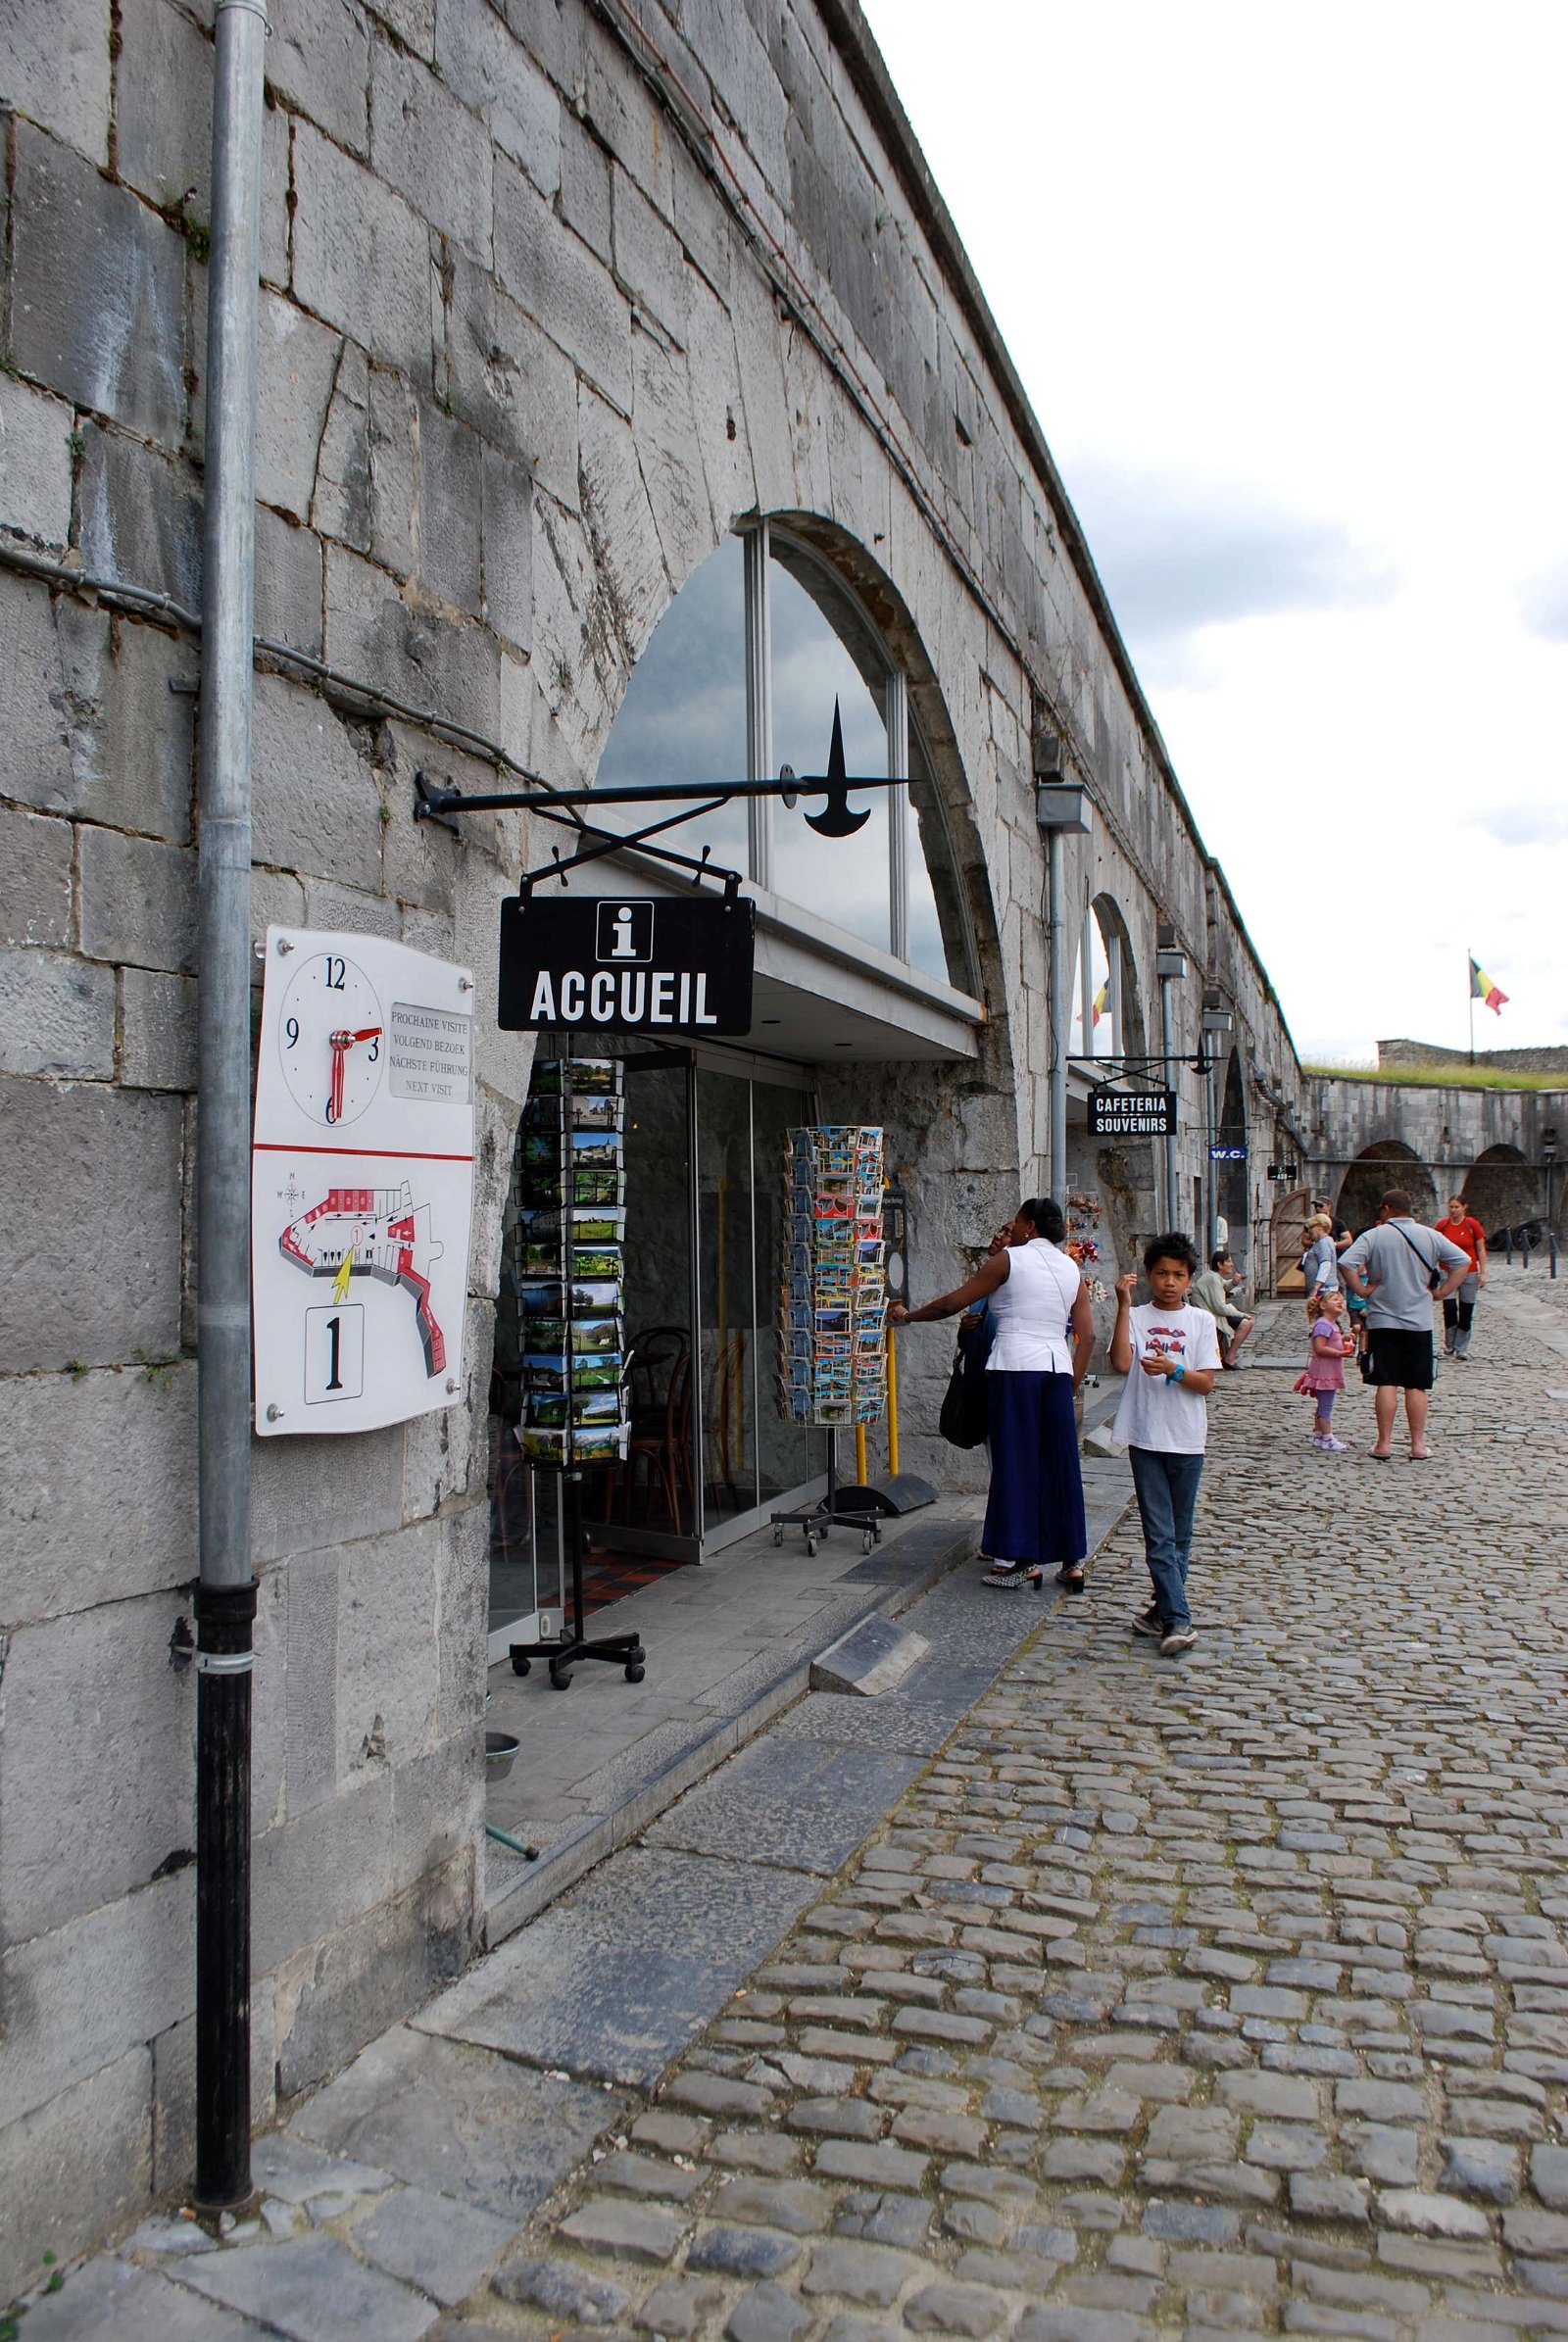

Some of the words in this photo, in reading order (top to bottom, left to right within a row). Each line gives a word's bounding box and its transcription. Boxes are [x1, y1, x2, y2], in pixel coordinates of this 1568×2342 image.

[325, 956, 346, 991] 12
[529, 970, 717, 1024] ACCUEIL
[286, 1018, 299, 1049] 9
[392, 1010, 440, 1030] PROCHAINE
[441, 1020, 468, 1035] VISITE
[368, 1037, 379, 1061] 3
[393, 1034, 433, 1050] VOLGEND
[434, 1040, 466, 1055] BEZOEK
[389, 1054, 428, 1072] NÄCHSTE
[429, 1060, 468, 1077] FÜHRUNG
[406, 1080, 429, 1094] NEXT
[431, 1083, 453, 1096] VISIT
[1096, 1098, 1167, 1112] CAFETERIA
[1096, 1117, 1167, 1133] SOUVENIRS
[1210, 1149, 1246, 1159] W.C.
[326, 1317, 343, 1391] 1
